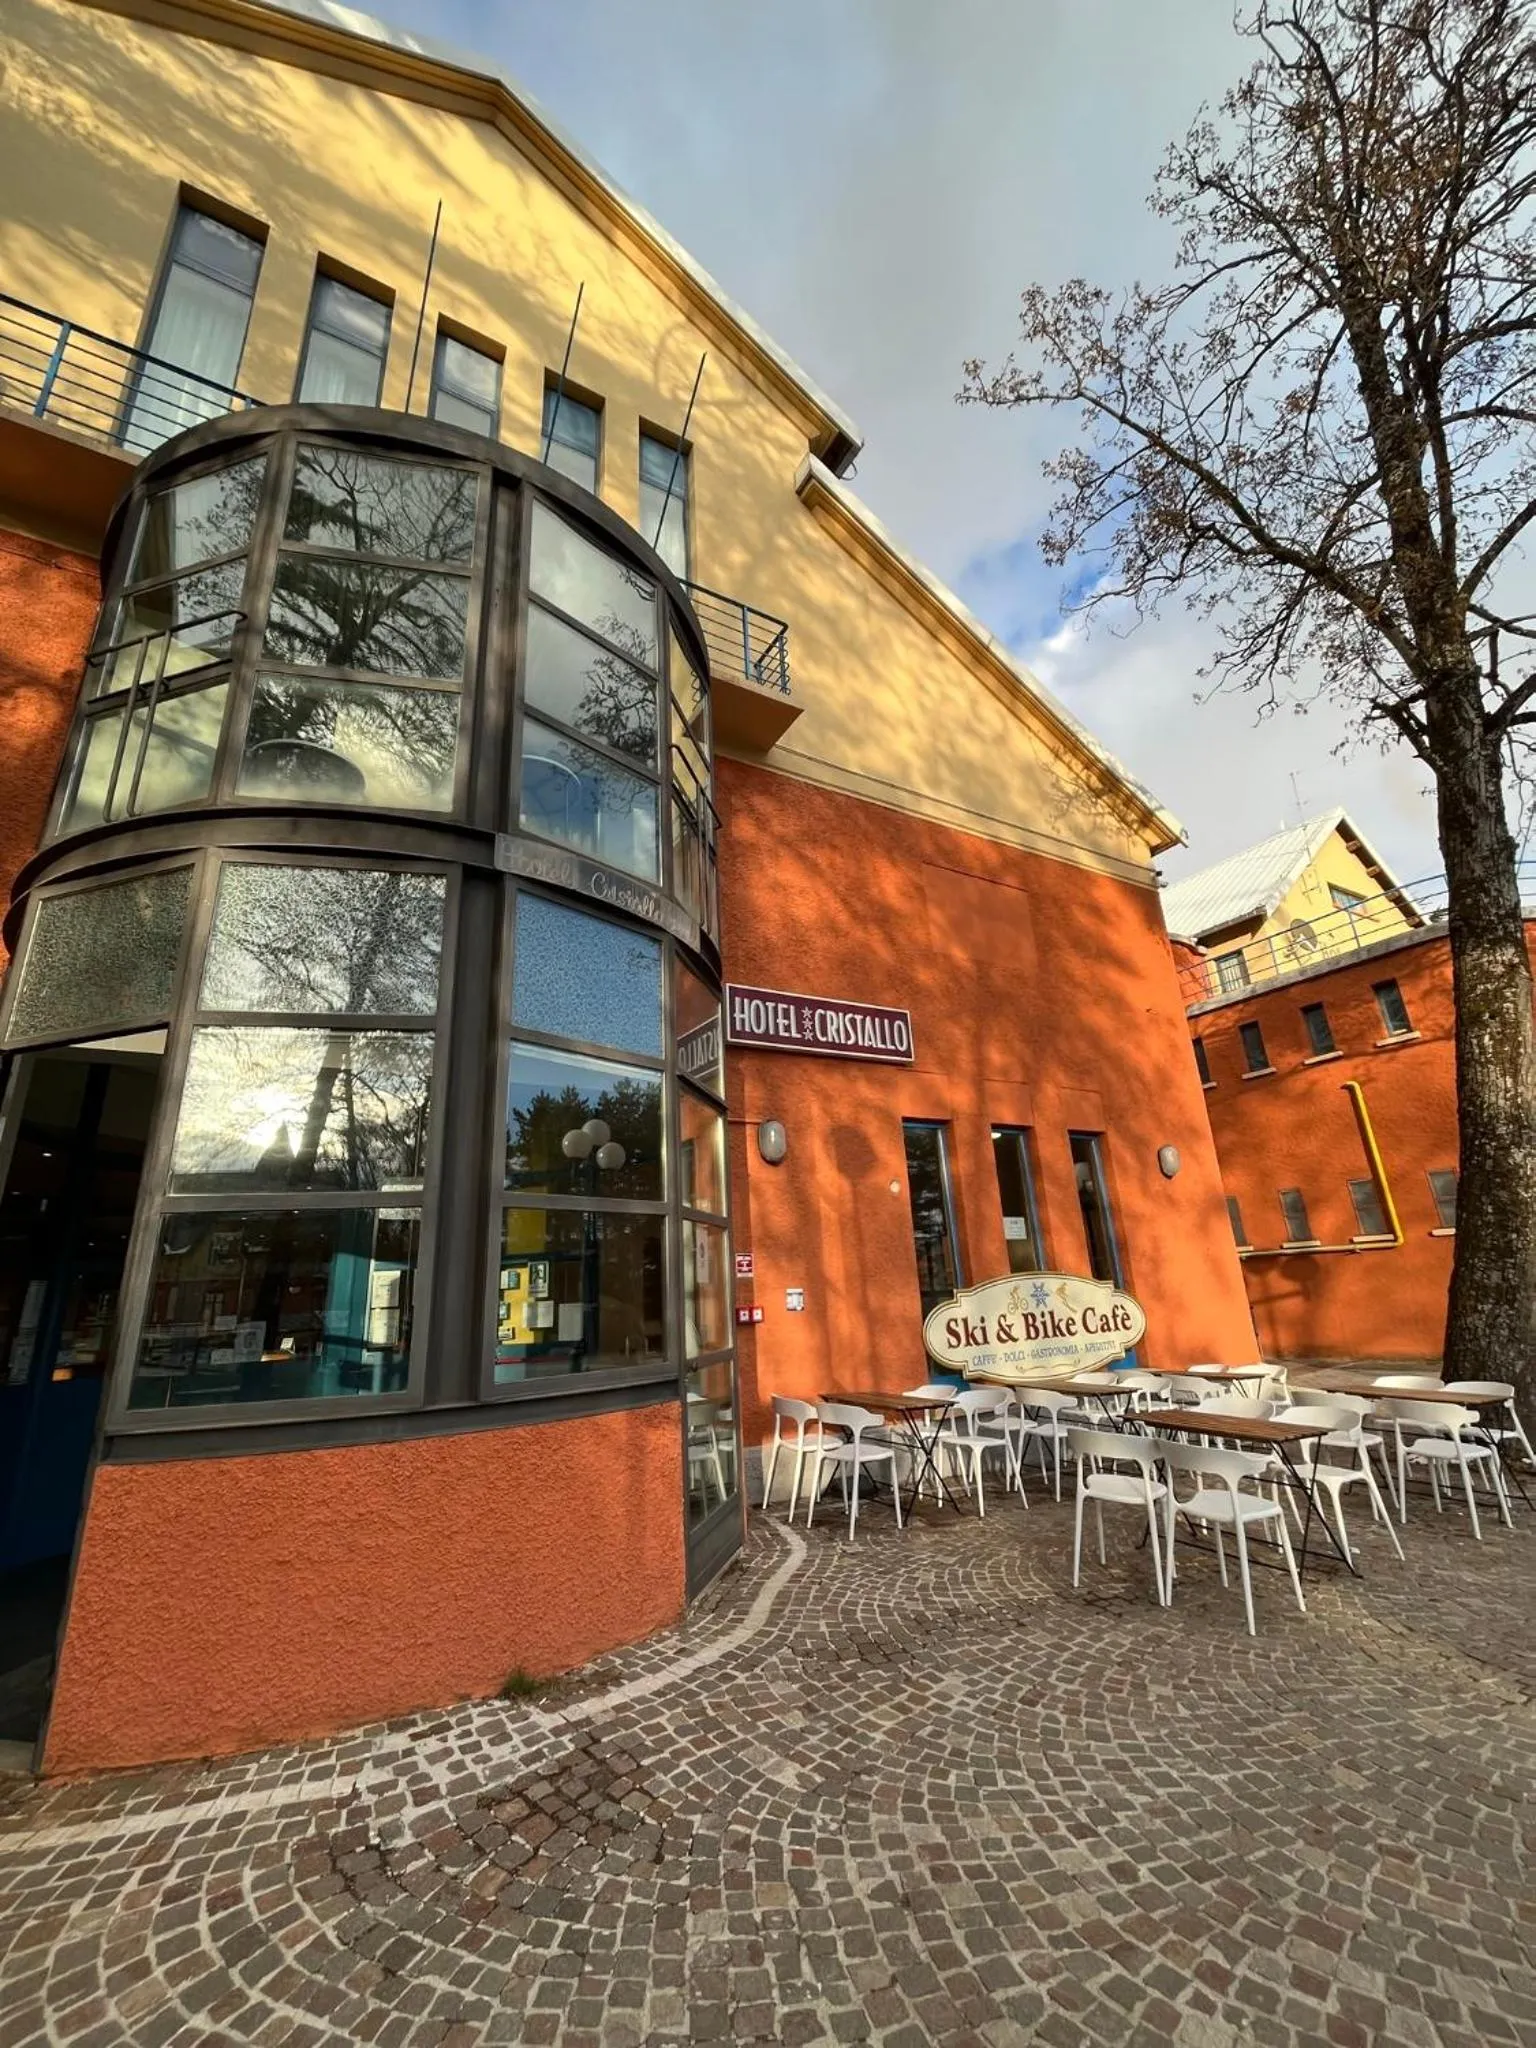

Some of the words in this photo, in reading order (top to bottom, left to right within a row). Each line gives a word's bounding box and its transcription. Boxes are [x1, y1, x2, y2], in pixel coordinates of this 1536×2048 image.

[734, 997, 802, 1038] HOTEL
[815, 1008, 908, 1052] CRISTALLO
[945, 1315, 989, 1349] Ski
[996, 1313, 1019, 1344] &
[1022, 1310, 1078, 1341] Bike
[1082, 1304, 1133, 1335] Cafè
